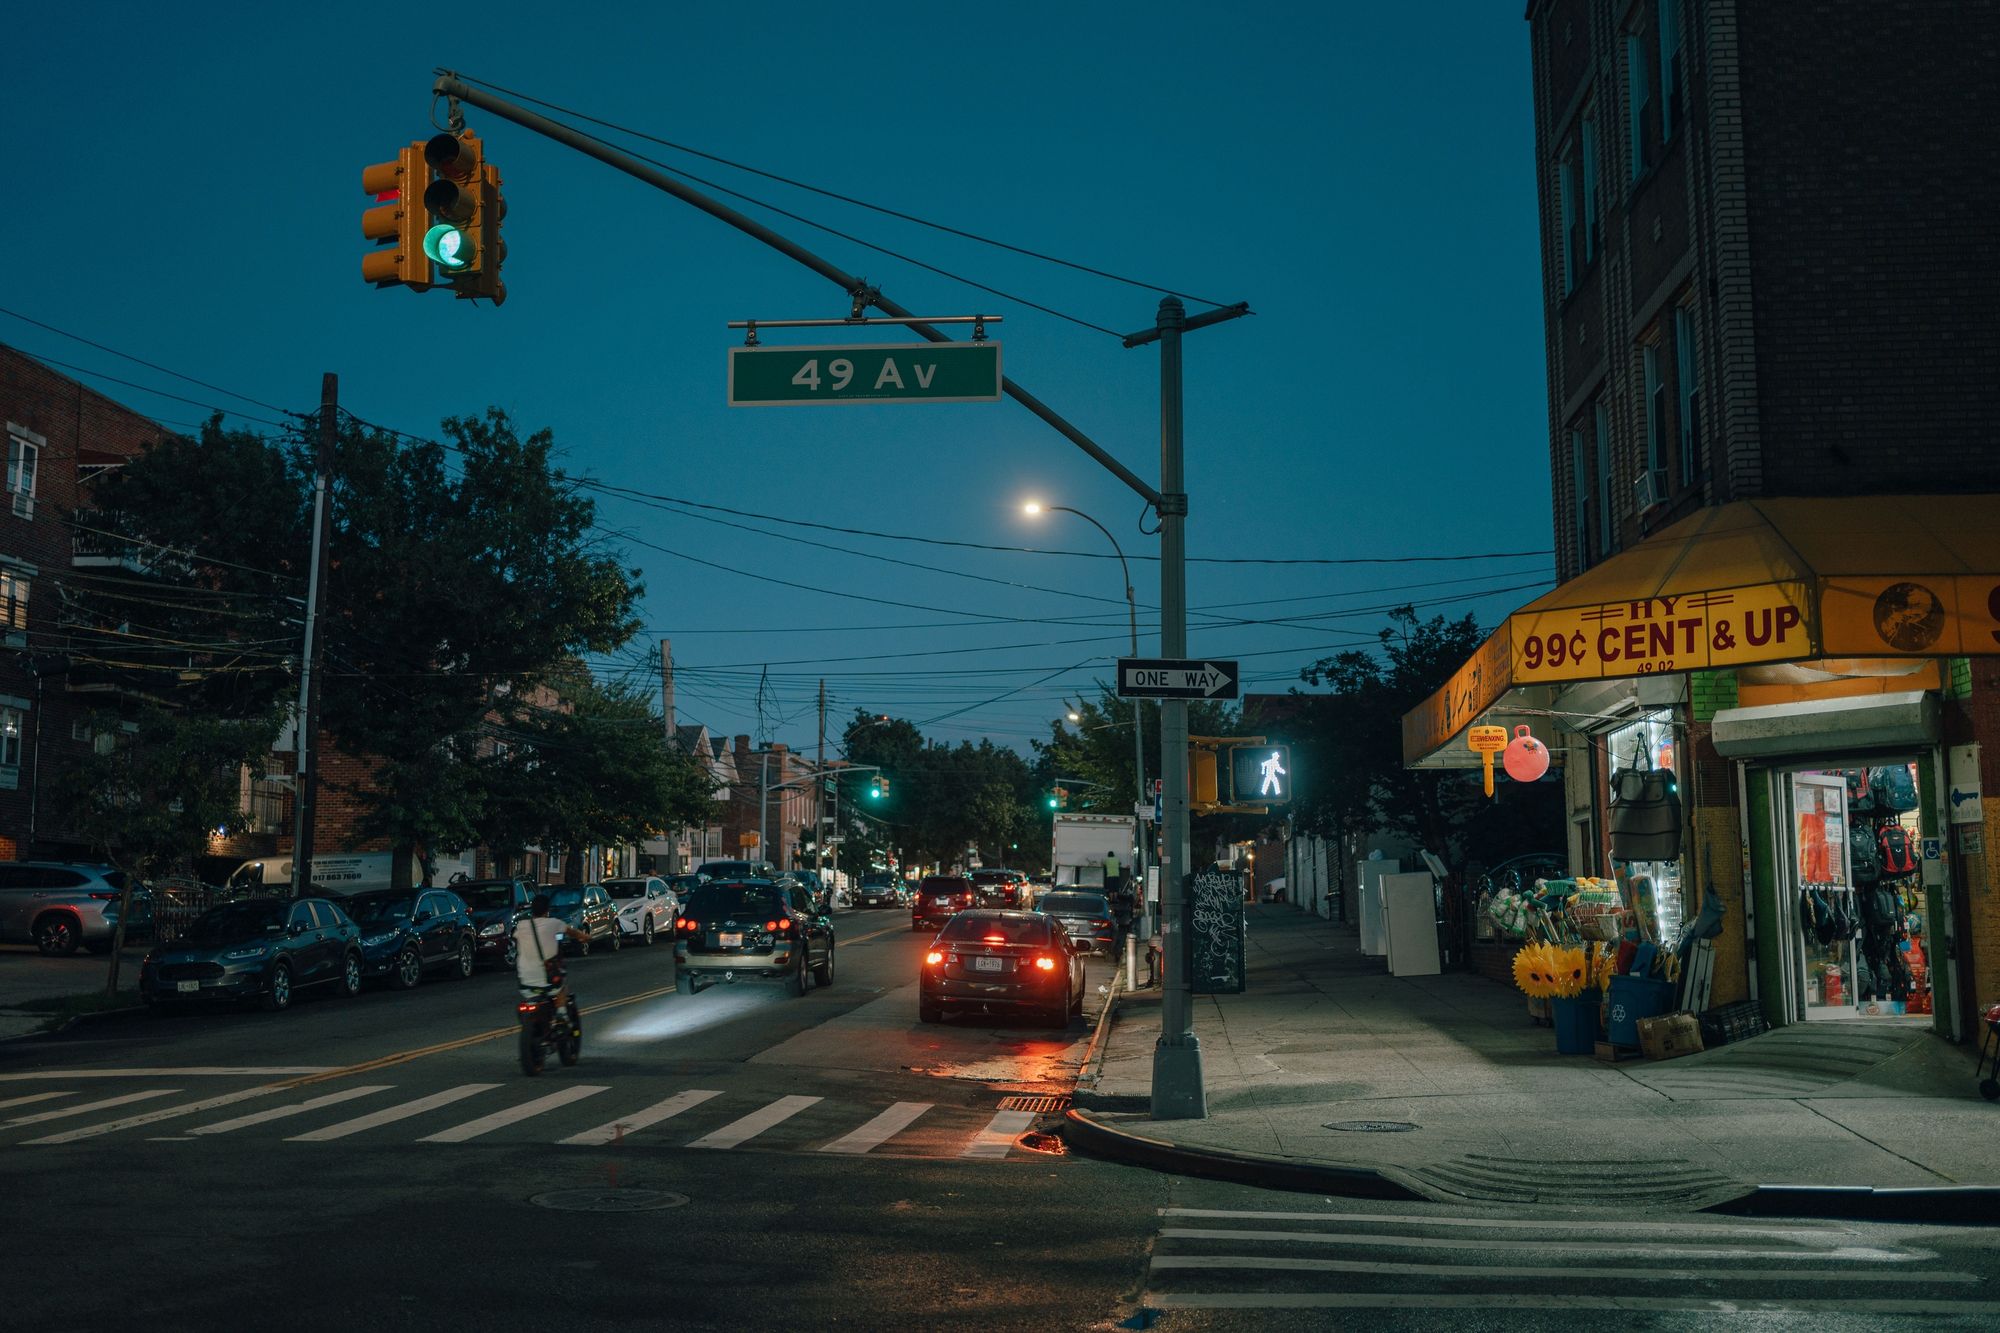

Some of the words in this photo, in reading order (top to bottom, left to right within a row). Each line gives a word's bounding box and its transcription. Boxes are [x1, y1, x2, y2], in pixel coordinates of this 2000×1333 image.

[791, 358, 855, 391] 49
[874, 357, 937, 389] Av
[1630, 596, 1682, 620] HY
[1524, 629, 1587, 669] 99¢
[1597, 618, 1702, 662] CENT
[1712, 620, 1736, 650] &
[1745, 605, 1800, 647] UP
[1135, 671, 1169, 686] ONE
[1185, 672, 1220, 687] WAY
